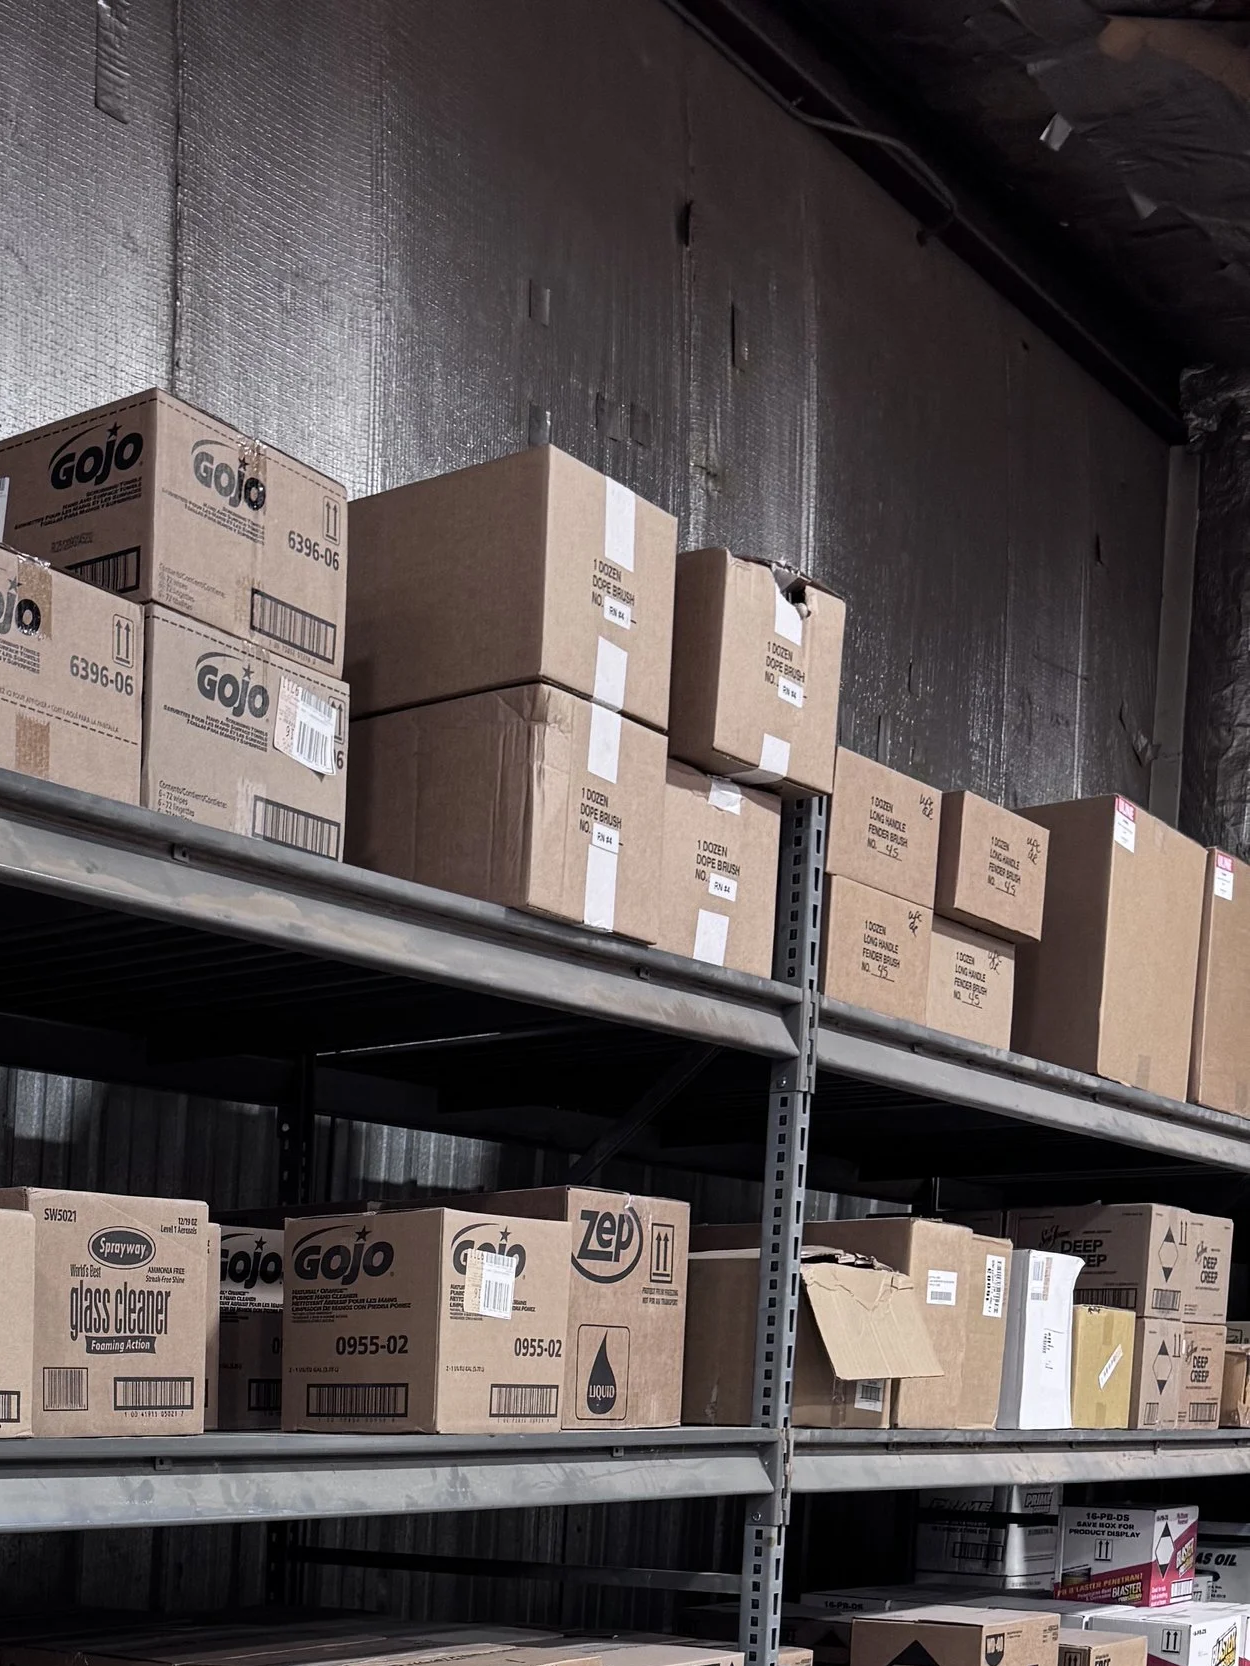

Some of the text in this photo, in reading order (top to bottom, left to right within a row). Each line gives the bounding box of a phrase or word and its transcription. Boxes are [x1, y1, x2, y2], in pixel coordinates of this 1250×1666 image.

[288, 530, 340, 573] 6396-06
[599, 560, 621, 582] DOZEN
[592, 575, 635, 607] DOPE BRUSH
[69, 654, 134, 697] 6396-06
[875, 797, 893, 814] DOZEN
[870, 809, 907, 833] LONG HANDLE
[868, 824, 908, 849] FENDER BRUSH
[44, 1207, 77, 1223] SW5021
[99, 1237, 147, 1259] Sprayway
[1061, 1239, 1104, 1254] DEEP
[1202, 1256, 1218, 1270] DEEP
[1200, 1270, 1218, 1285] CREEP
[70, 1279, 171, 1342] glass cleaner
[91, 1338, 150, 1353] Foaming Action
[335, 1334, 409, 1356] 0955-02
[514, 1337, 562, 1358] 0955-02
[1192, 1356, 1209, 1369] DEEP
[1190, 1370, 1209, 1383] CREEP
[589, 1385, 615, 1401] LIQUID
[1086, 1512, 1130, 1521] 16-PB-DS
[1214, 1554, 1237, 1566] OIL
[1111, 1581, 1142, 1598] BLASTER
